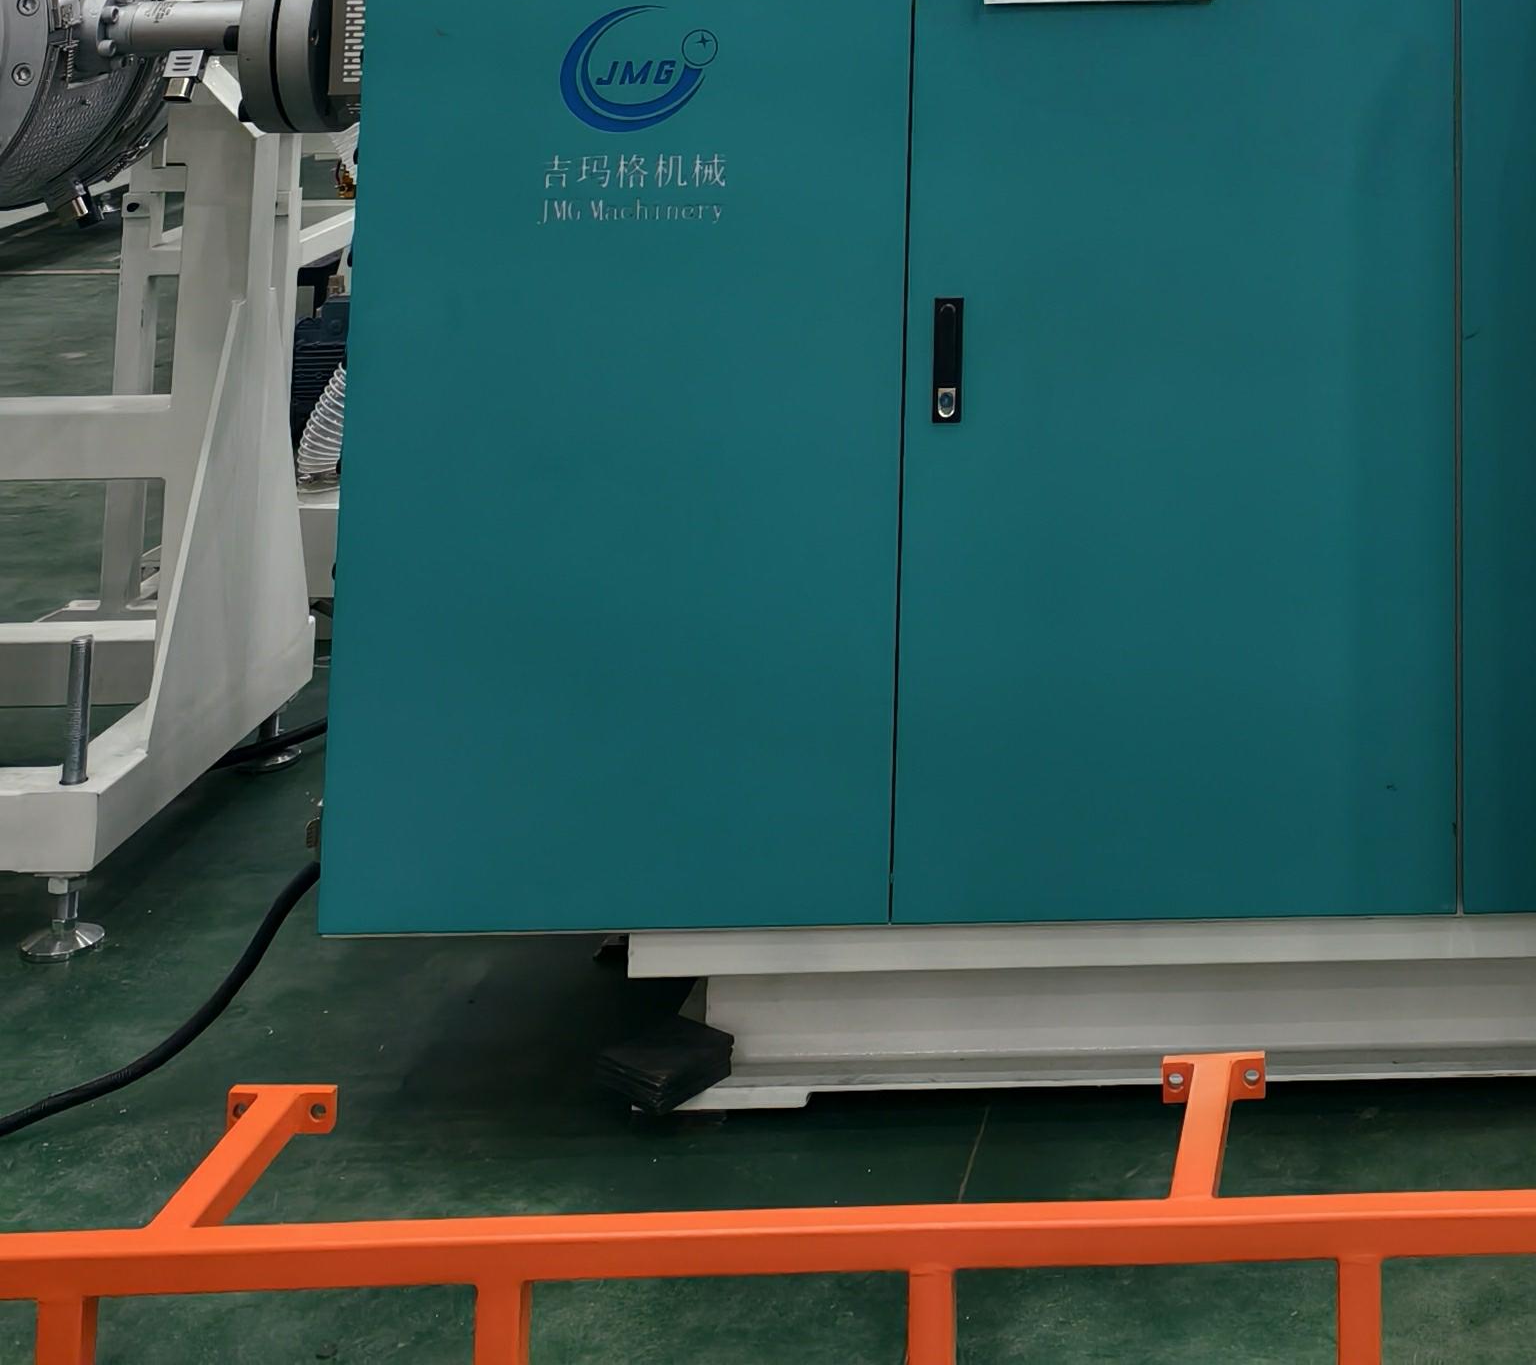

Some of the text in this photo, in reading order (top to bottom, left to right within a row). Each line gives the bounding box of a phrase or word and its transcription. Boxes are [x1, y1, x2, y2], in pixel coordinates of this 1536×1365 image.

[596, 60, 676, 86] JMG
[542, 153, 727, 189] 吉玛格机械
[537, 198, 722, 225] JMG Machinery
